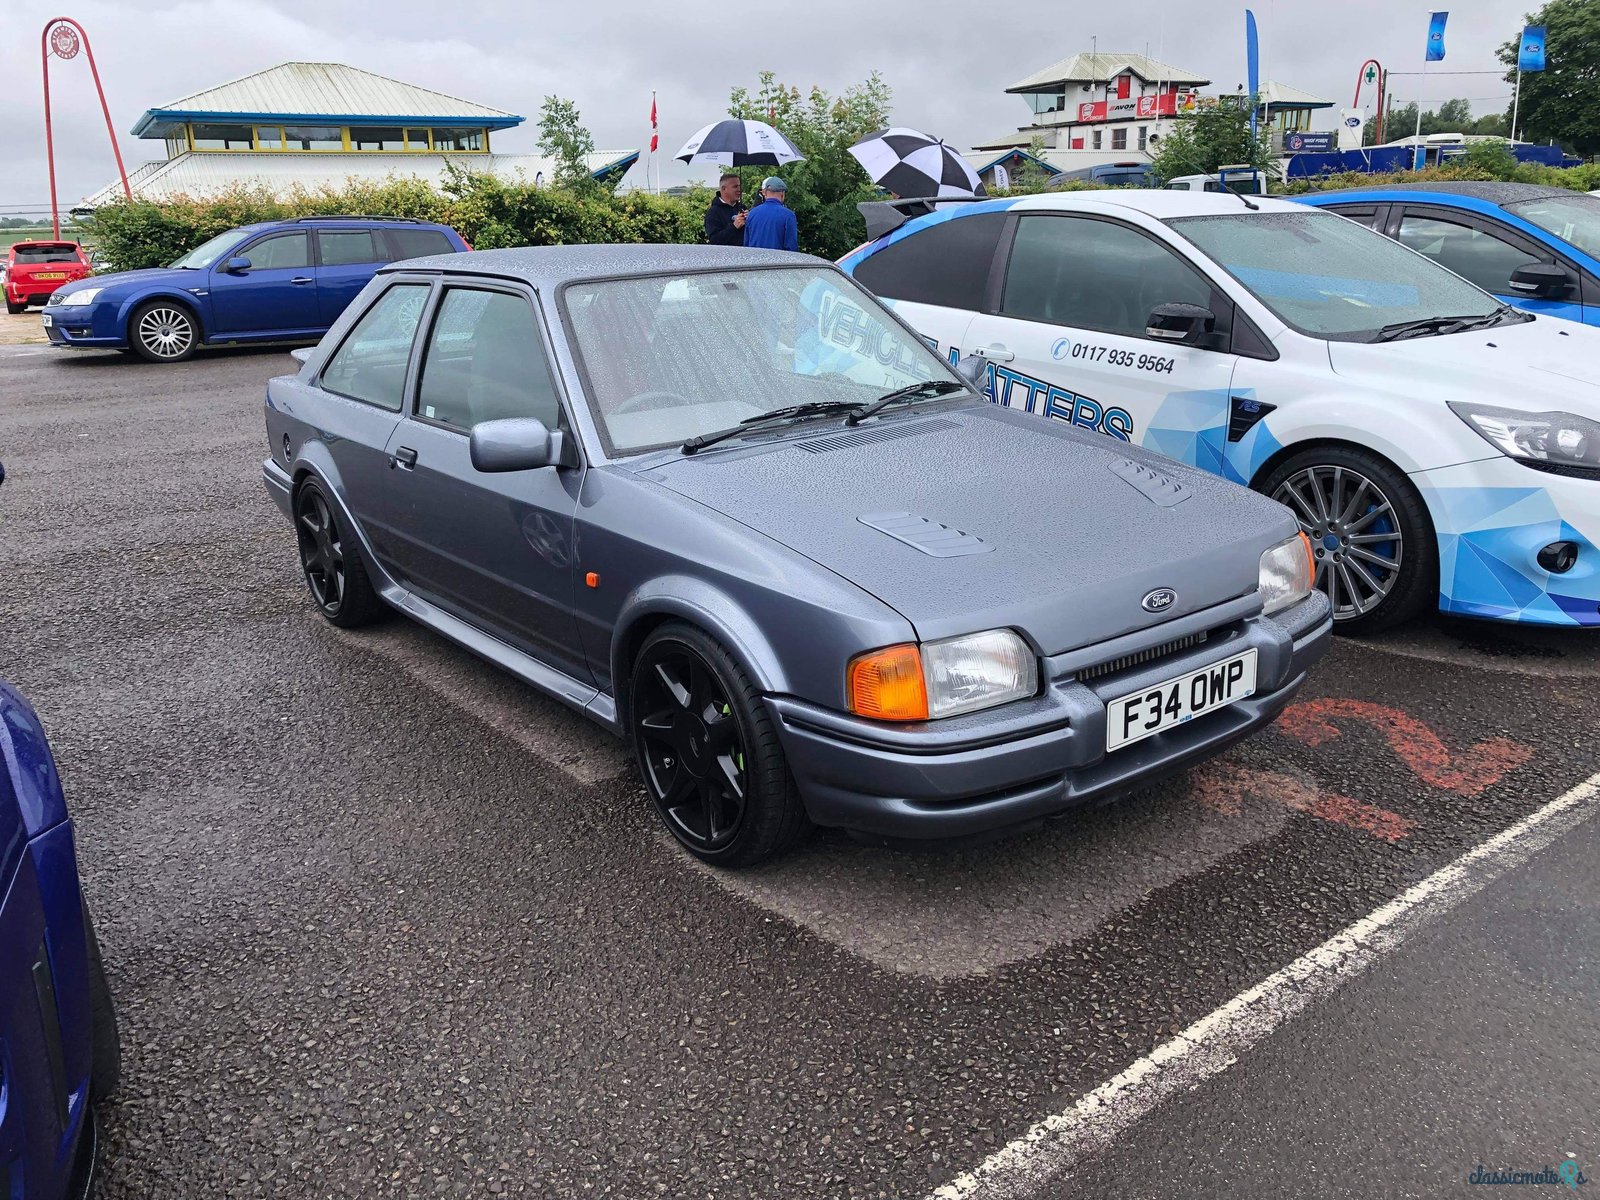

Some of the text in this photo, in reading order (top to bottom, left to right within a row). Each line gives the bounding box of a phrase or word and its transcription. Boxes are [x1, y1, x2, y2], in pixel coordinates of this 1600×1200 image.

[1114, 103, 1136, 111] AVON
[1072, 343, 1175, 374] 0117 935 9564
[1123, 659, 1244, 740] F34 OWP
